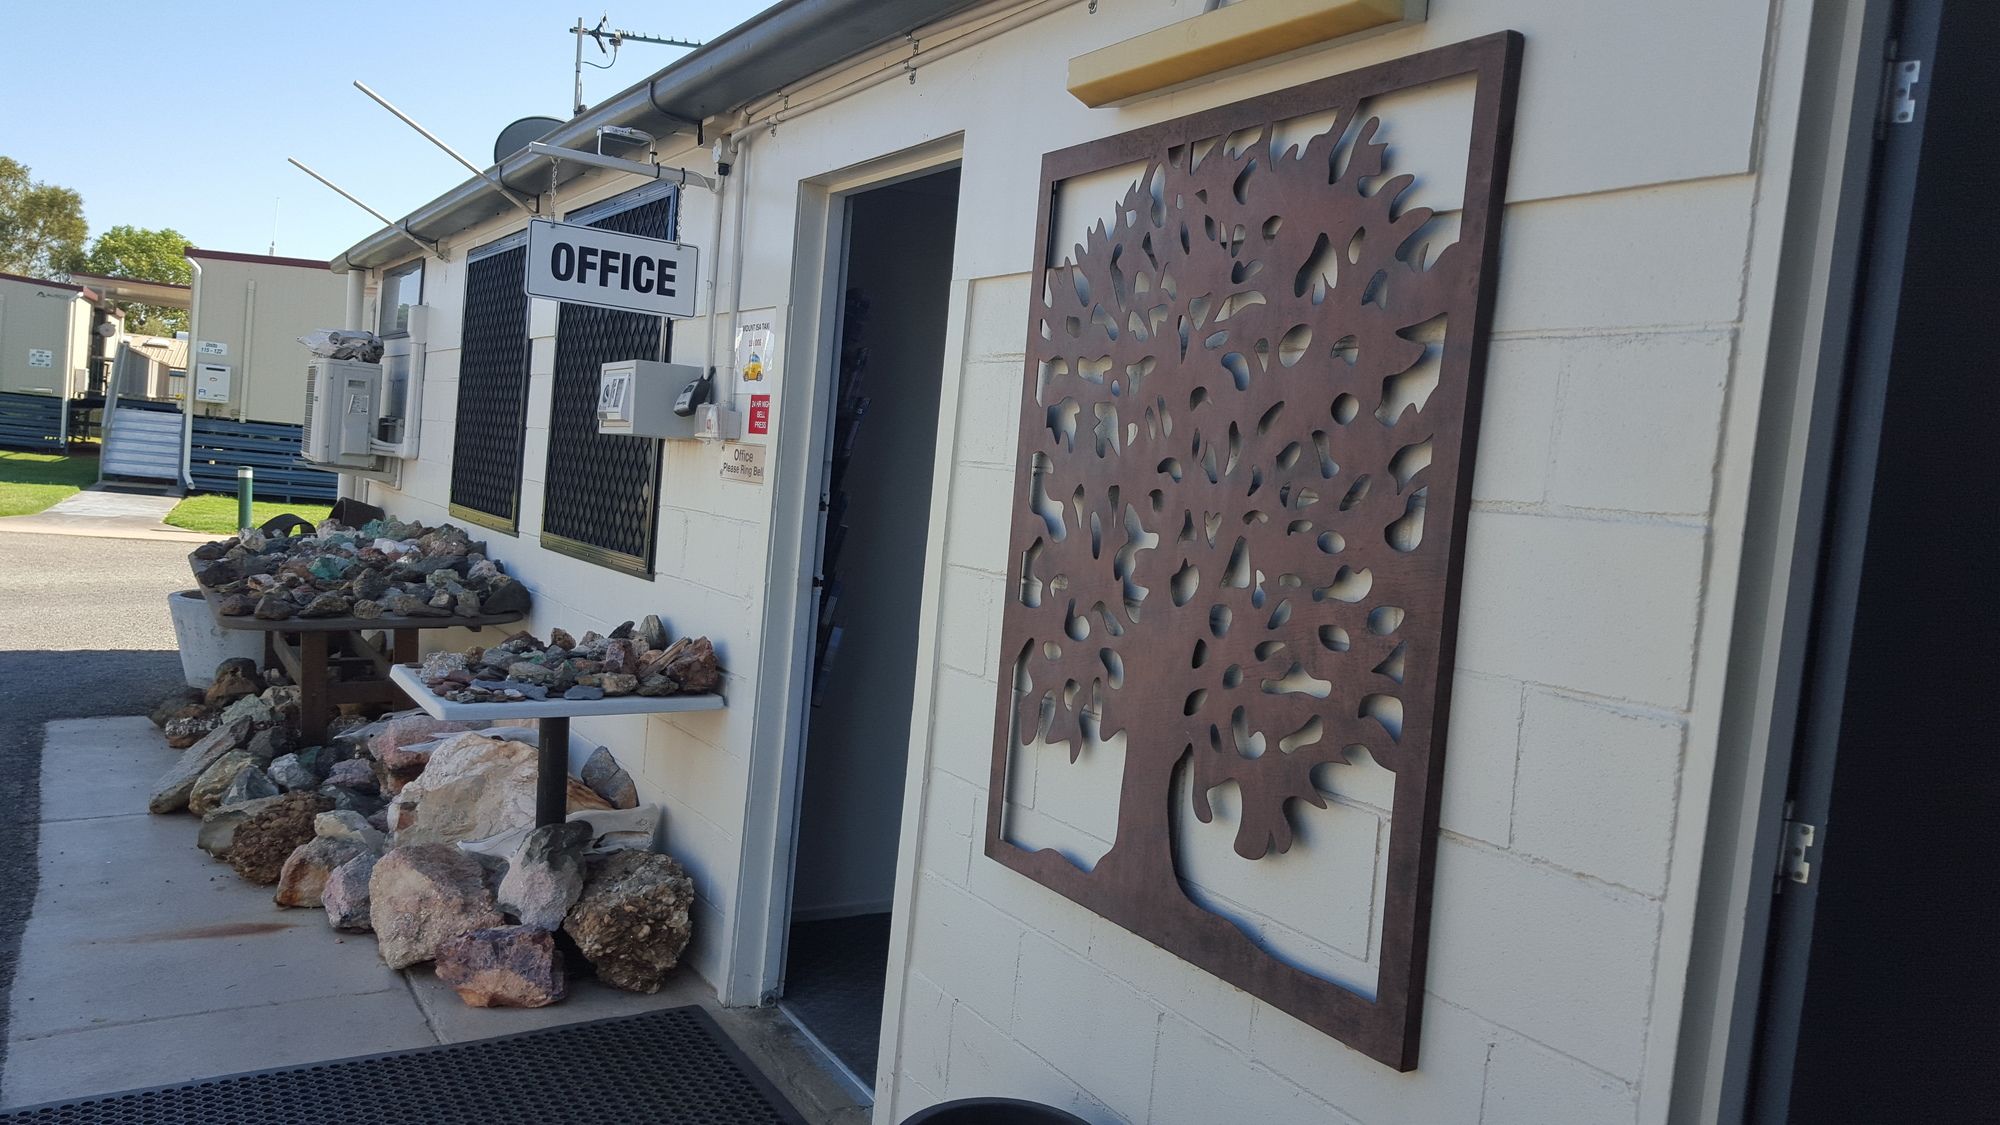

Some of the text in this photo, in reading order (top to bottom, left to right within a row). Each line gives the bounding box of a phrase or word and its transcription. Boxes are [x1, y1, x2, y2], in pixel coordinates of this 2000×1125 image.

[551, 242, 677, 298] OFFICE
[755, 421, 767, 429] PRESS
[734, 449, 753, 462] Office
[723, 462, 764, 477] Please Ring Bell
